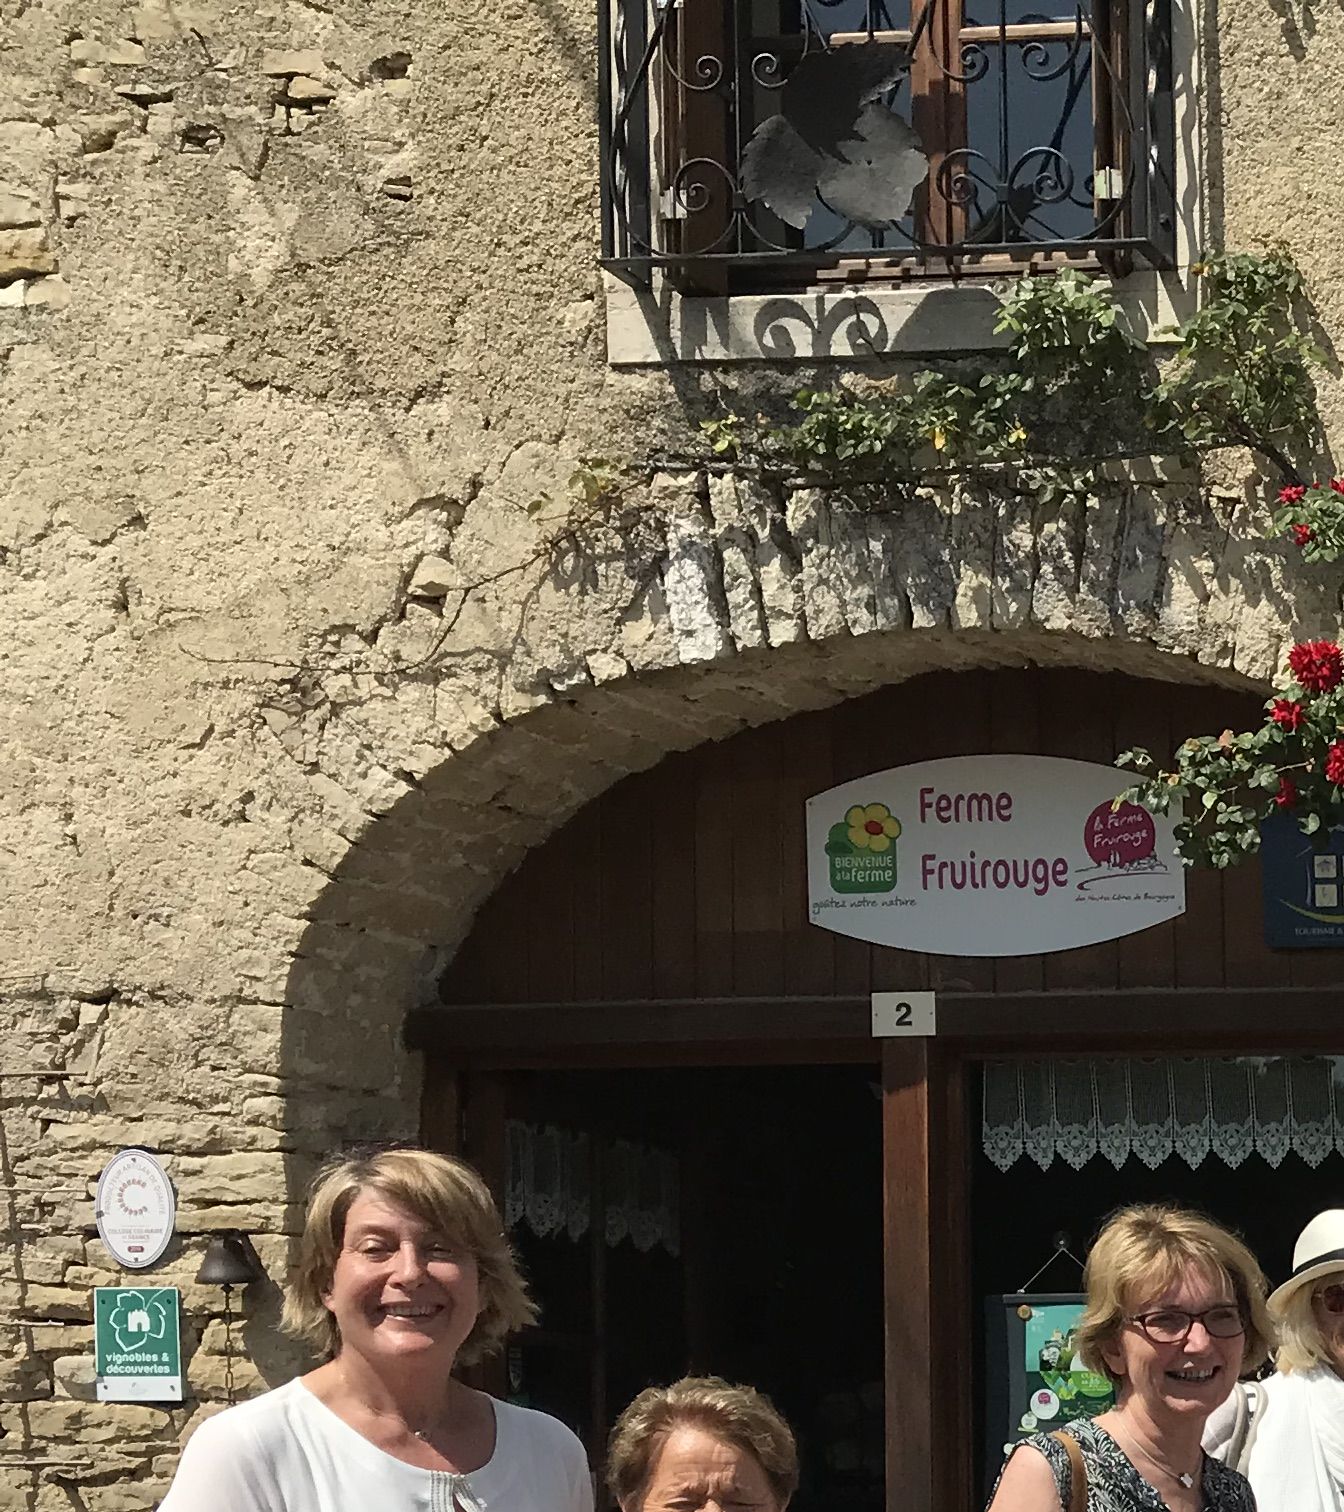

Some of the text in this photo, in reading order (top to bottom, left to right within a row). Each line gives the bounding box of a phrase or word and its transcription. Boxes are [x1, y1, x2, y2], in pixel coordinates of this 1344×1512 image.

[920, 787, 1012, 823] Ferme
[1108, 814, 1143, 829] Ferme
[1094, 829, 1148, 848] Fruirouge
[835, 856, 894, 868] BIENVENUE
[851, 868, 893, 882] ferme
[922, 850, 1068, 896] Fruirouge
[812, 896, 918, 915] goûtez notre nature
[895, 1002, 912, 1027] 2
[105, 1352, 170, 1365] vignobles &
[106, 1364, 170, 1374] découvertes
